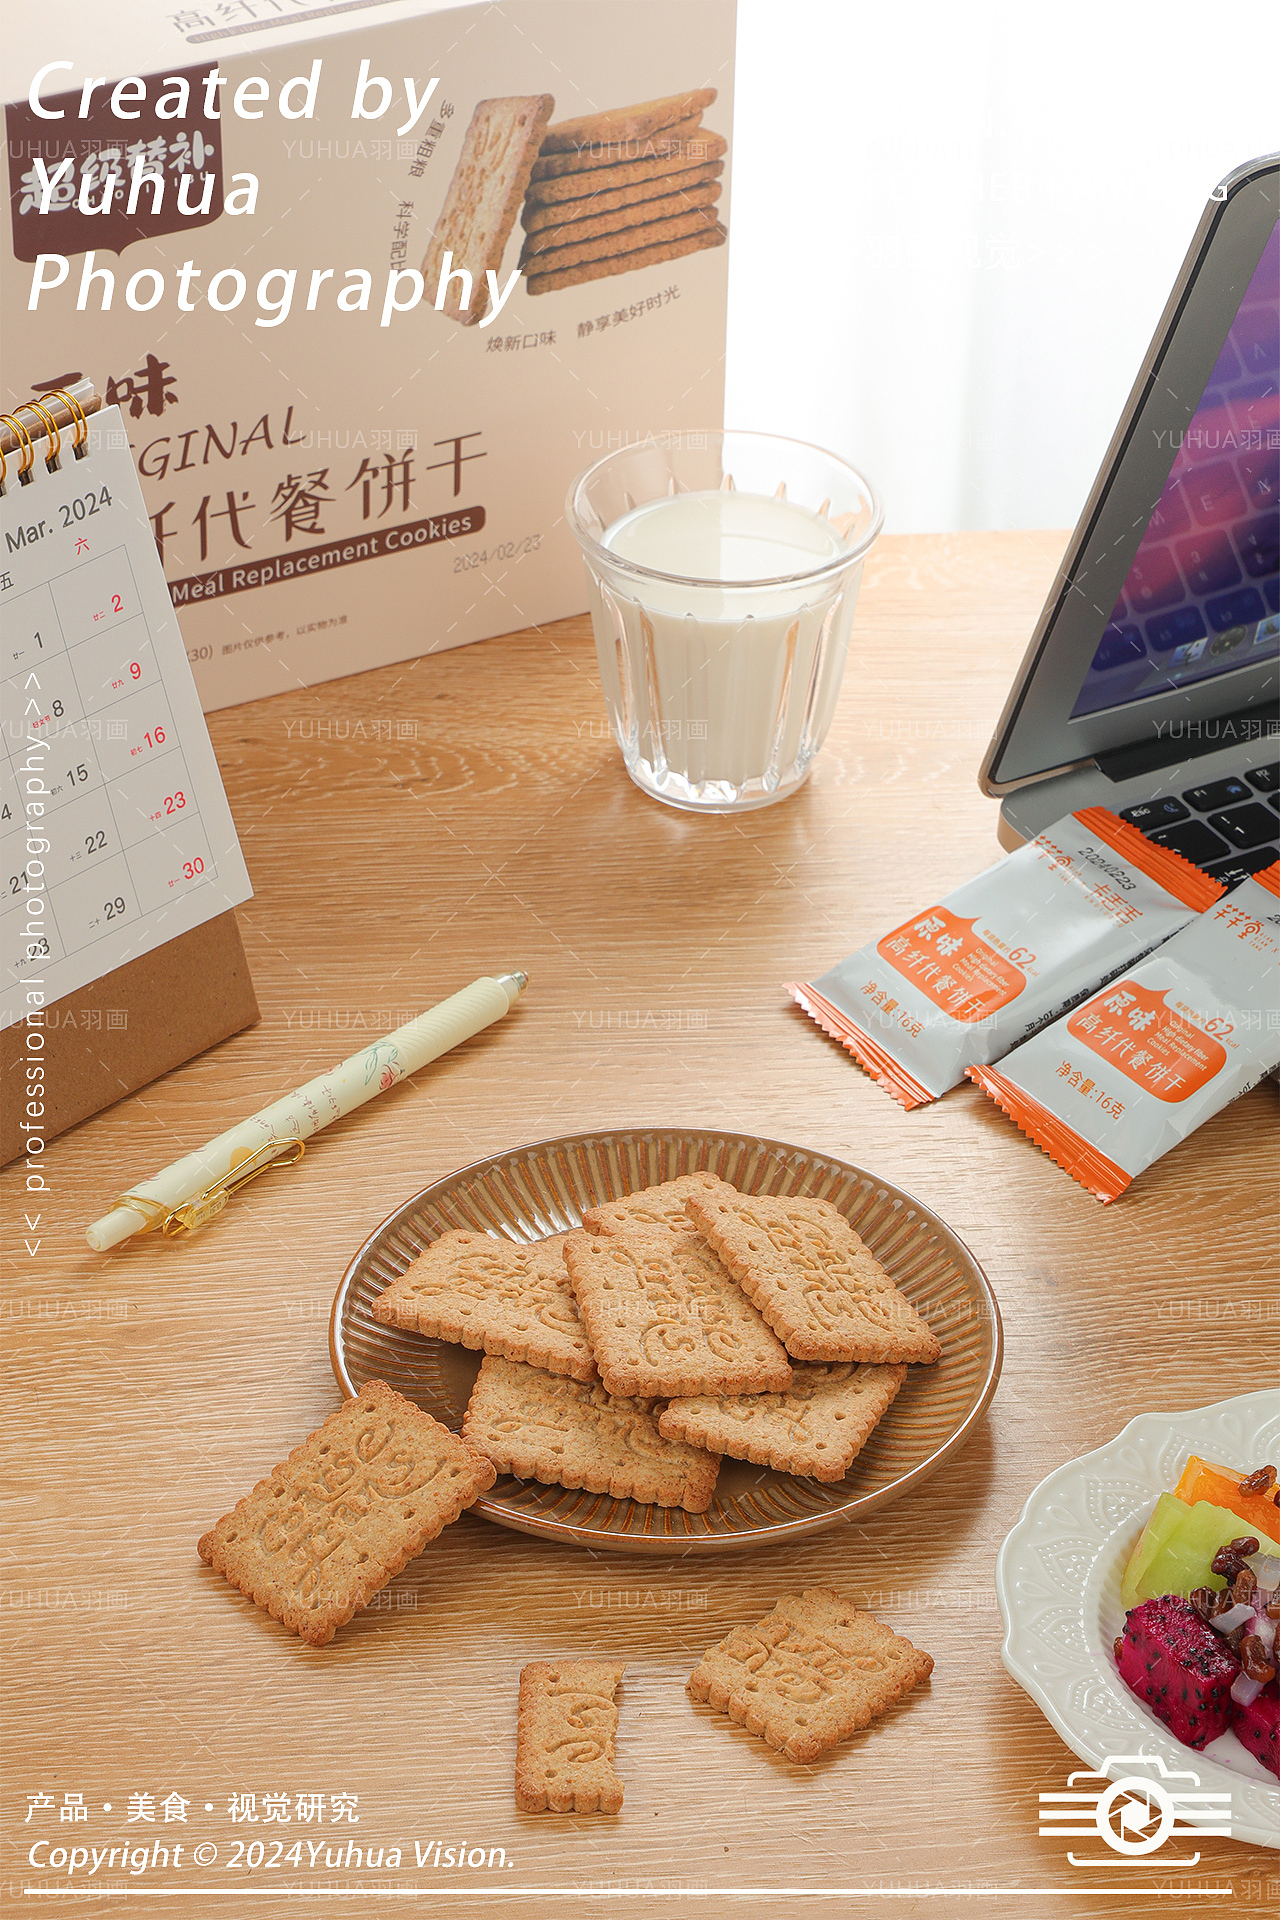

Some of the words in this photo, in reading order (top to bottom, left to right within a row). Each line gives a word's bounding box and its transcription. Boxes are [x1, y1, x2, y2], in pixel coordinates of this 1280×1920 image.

[408, 100, 454, 177] 多重粗粮
[485, 330, 557, 353] 焕新口味
[577, 285, 681, 339] 静享美好时光
[130, 406, 306, 481] GINAL
[150, 432, 487, 567] 代餐饼干
[5, 519, 53, 553] Mar.
[58, 486, 112, 528] 2024
[74, 537, 90, 556] 六
[171, 572, 224, 604] Meal
[233, 536, 379, 588] Replacement
[384, 514, 473, 549] Cookies
[453, 534, 542, 574] 2024/02/23
[111, 594, 124, 613] 2
[33, 631, 43, 649] 1
[130, 662, 142, 680] 9
[52, 699, 65, 718] 8
[143, 726, 166, 749] 16
[66, 763, 89, 787] 15
[163, 791, 187, 815] 23
[84, 830, 108, 855] 22
[182, 857, 205, 879] 30
[1078, 847, 1136, 890] 20240223
[9, 871, 29, 895] 21
[103, 896, 126, 920] 29
[914, 916, 963, 957] 原味
[1008, 947, 1037, 970] 62
[885, 936, 986, 1014] 高纤代餐饼干
[1104, 990, 1156, 1032] 原味
[1161, 1025, 1178, 1040] High
[1174, 1034, 1197, 1054] dietary
[1169, 1020, 1195, 1040] Original
[1204, 1017, 1234, 1041] 62
[1225, 1037, 1240, 1049] kcal
[1076, 1012, 1187, 1091] 高纤代餐饼干
[1146, 1037, 1170, 1056] Cookies
[1154, 1031, 1170, 1045] Meal
[1169, 1042, 1207, 1071] Replacement
